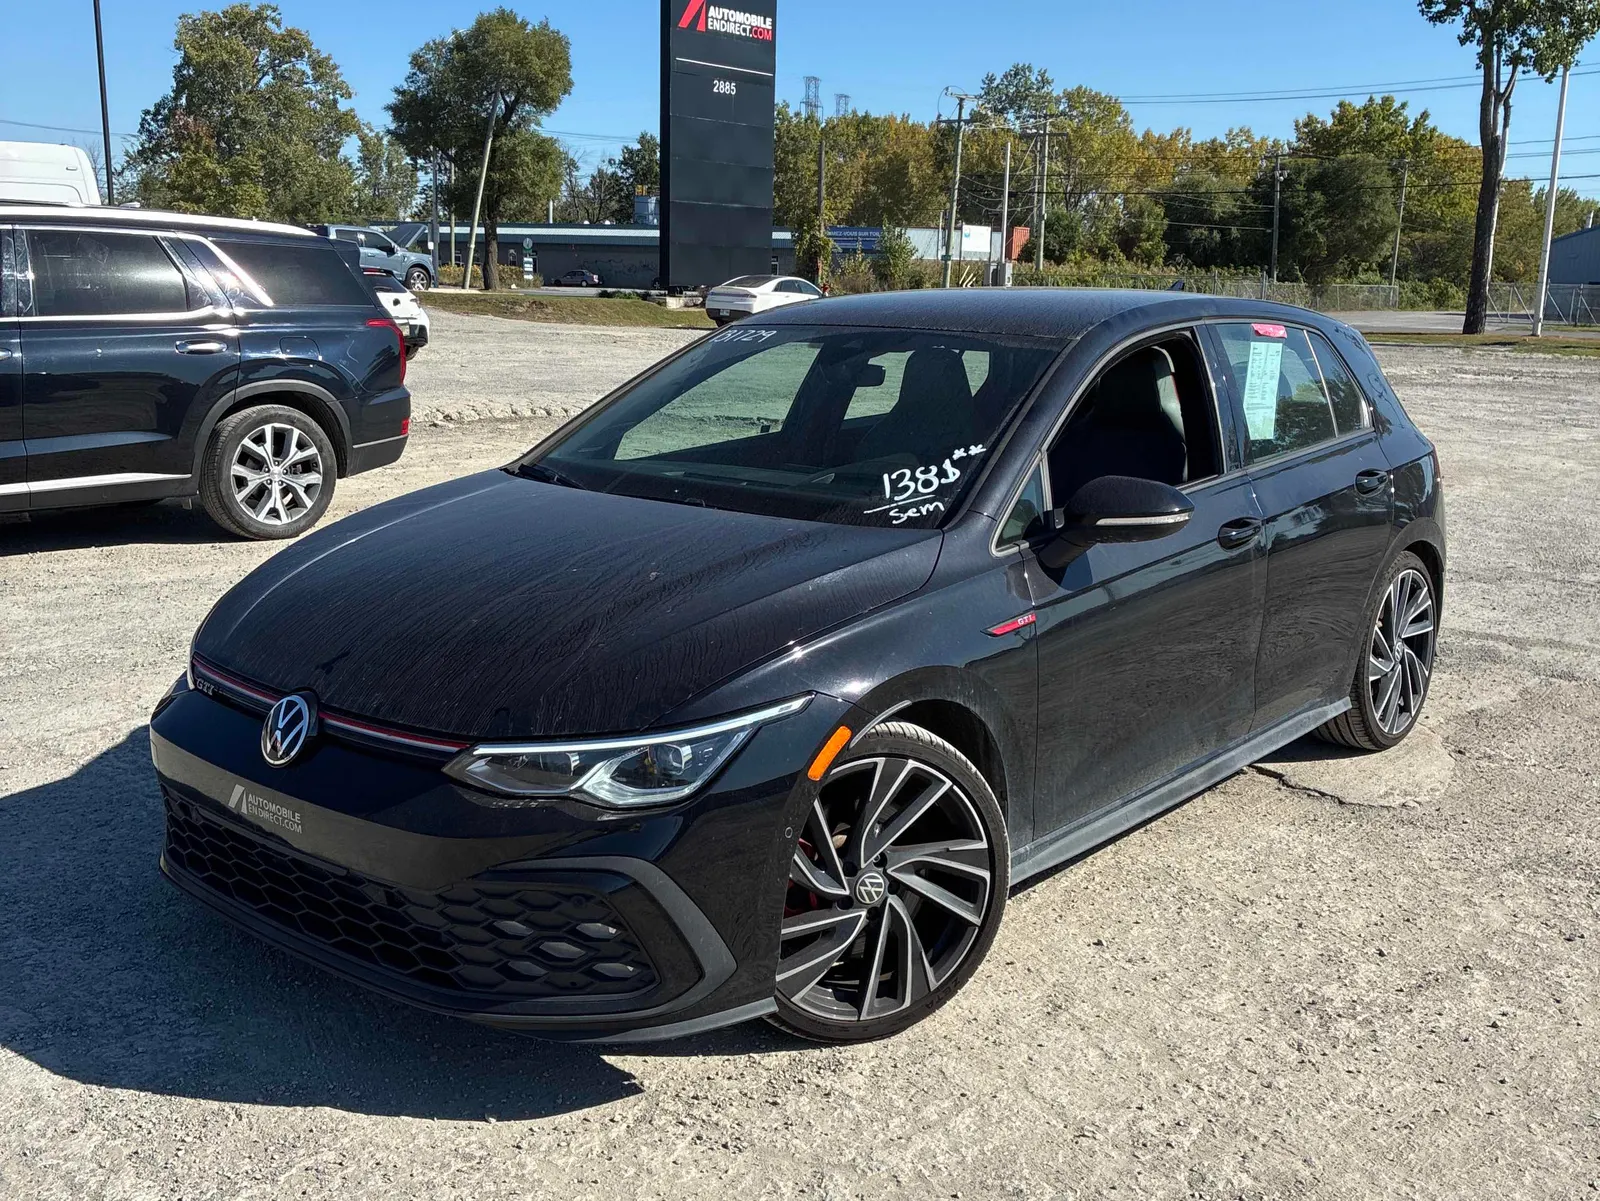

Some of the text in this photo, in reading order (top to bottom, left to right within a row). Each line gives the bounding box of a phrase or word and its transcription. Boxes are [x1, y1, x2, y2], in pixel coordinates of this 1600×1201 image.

[708, 5, 773, 29] AUTOMOBILE
[707, 17, 772, 41] ENDIRECT.COM
[713, 79, 736, 95] 2885
[1017, 614, 1033, 625] GTI
[196, 677, 215, 696] GTI
[247, 793, 302, 823] AUTOMOBILE
